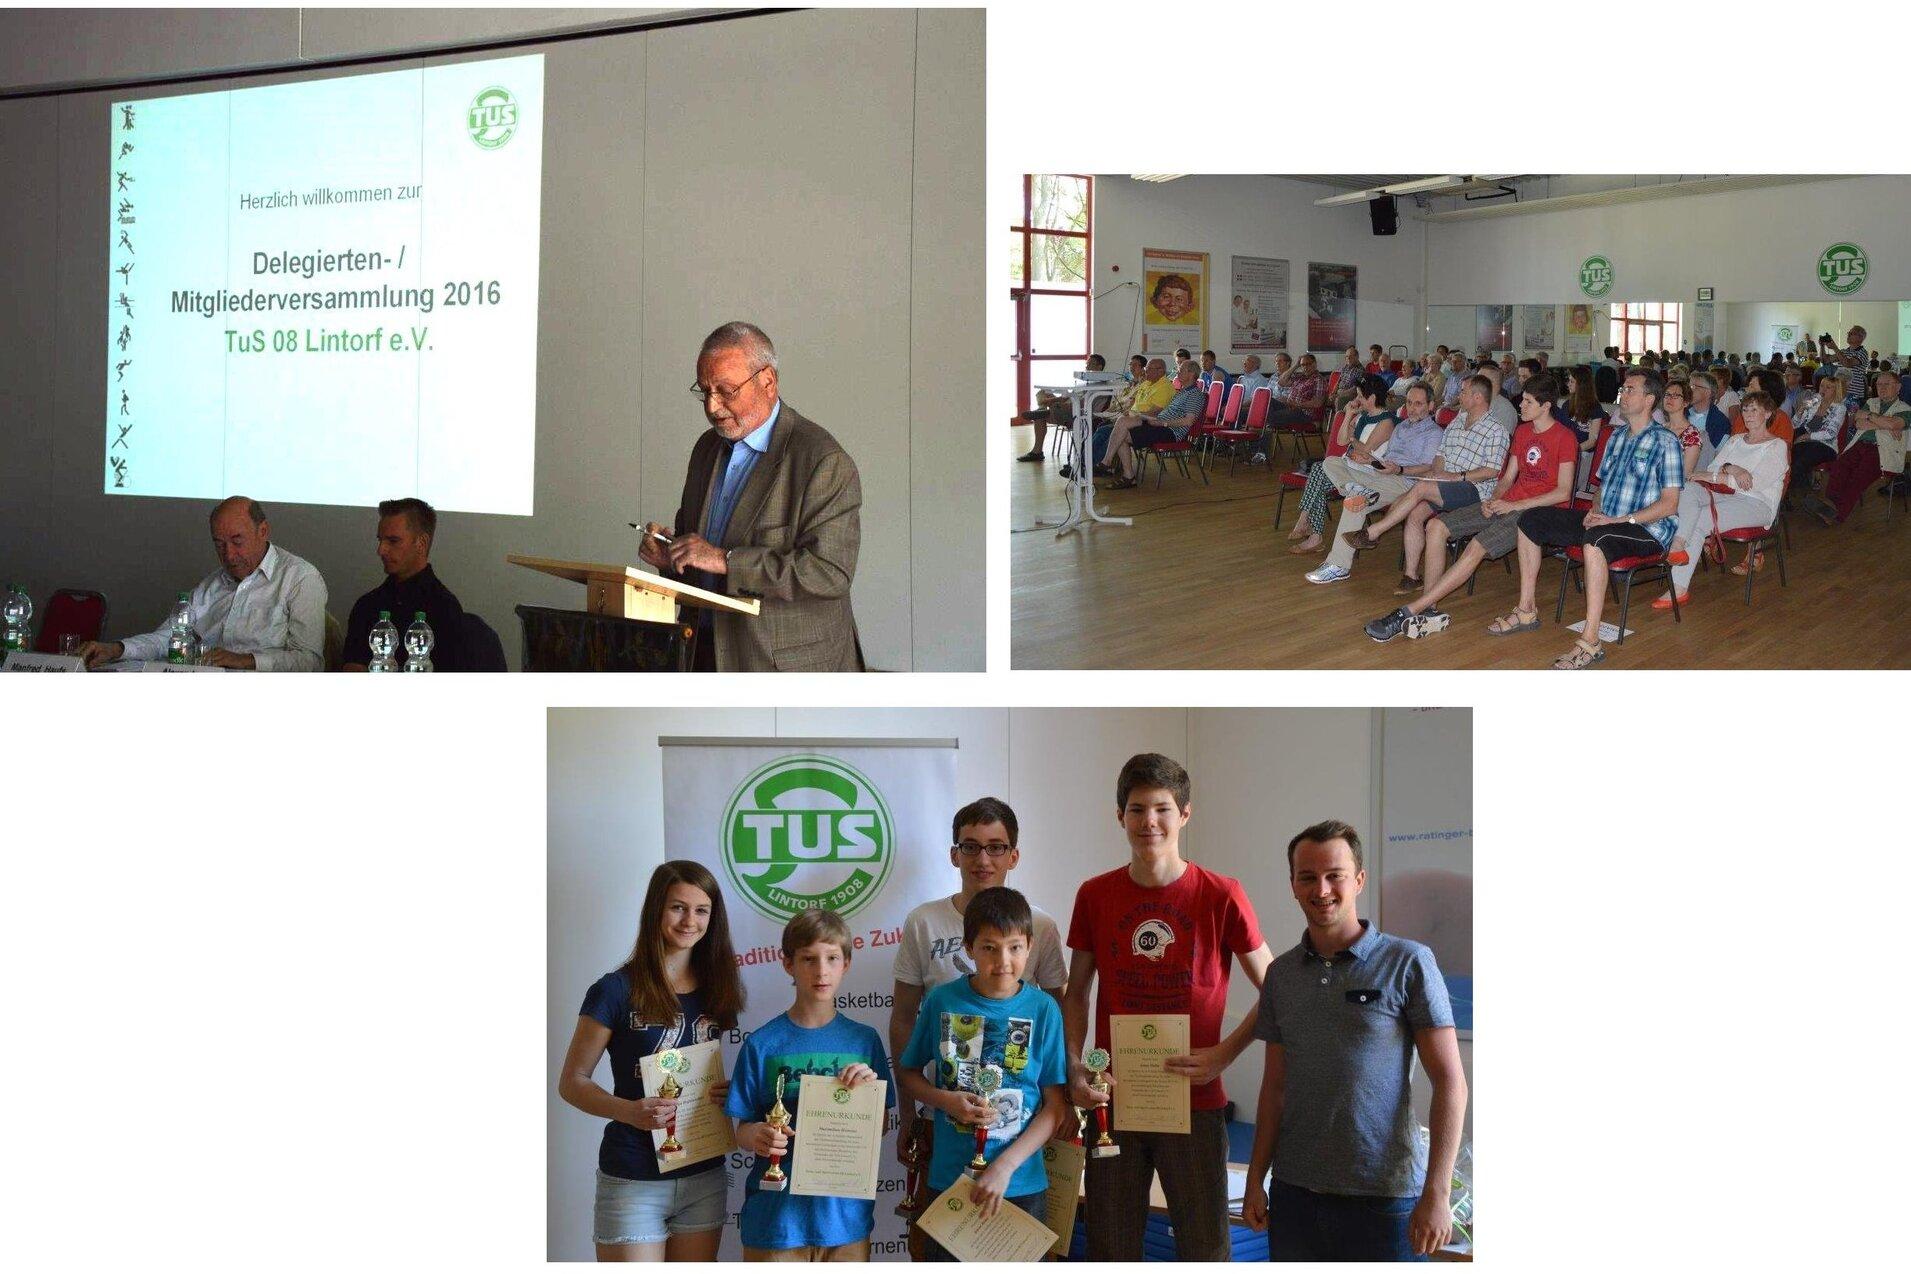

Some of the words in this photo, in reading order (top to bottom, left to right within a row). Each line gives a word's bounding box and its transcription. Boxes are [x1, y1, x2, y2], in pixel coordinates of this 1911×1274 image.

[471, 105, 515, 127] TUS
[240, 190, 298, 210] Herzlich
[302, 187, 392, 206] willkommen
[397, 184, 423, 200] zur
[253, 248, 391, 279] Delegierten-
[1582, 269, 1611, 283] TUS
[1822, 259, 1864, 276] TUS
[171, 284, 434, 318] Mitgliederversammlung
[443, 280, 501, 306] 2016
[224, 329, 266, 353] TuS
[273, 329, 298, 353] 08
[305, 327, 383, 353] Lintorf
[390, 326, 433, 352] e.V.
[743, 814, 877, 860] TUS
[768, 888, 827, 910] LINTORF
[831, 878, 864, 906] 1908
[1140, 935, 1156, 946] 60
[876, 1178, 906, 1193] zen
